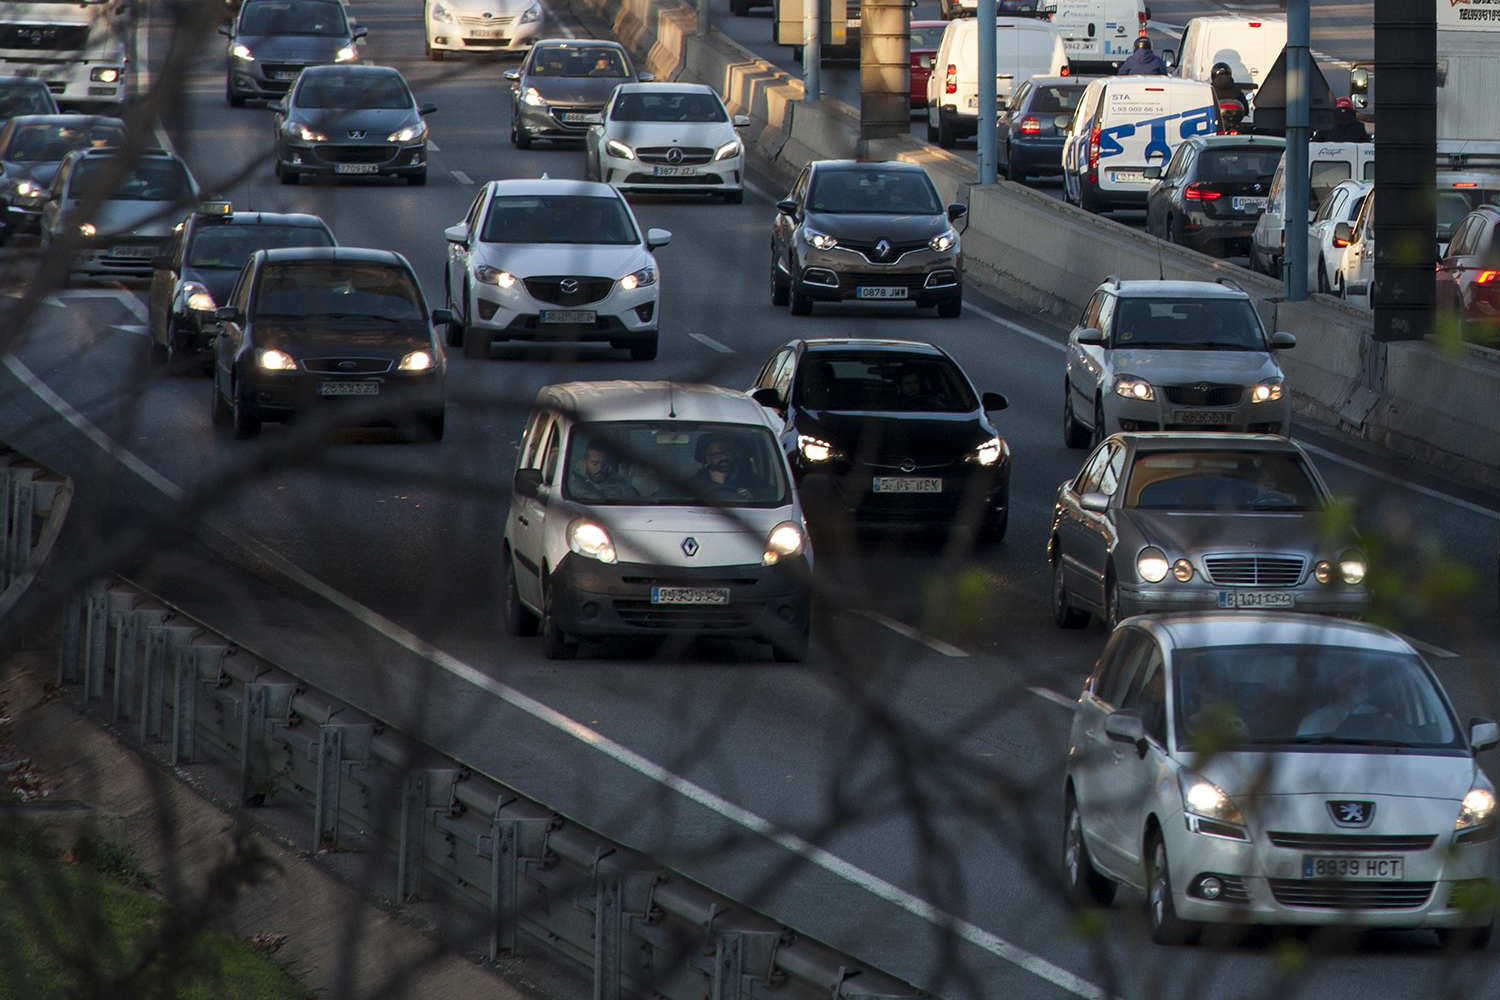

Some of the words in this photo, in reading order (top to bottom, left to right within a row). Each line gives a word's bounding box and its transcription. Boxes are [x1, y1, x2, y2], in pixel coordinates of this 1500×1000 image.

[863, 288, 886, 297] 0878
[1316, 860, 1360, 876] 8939
[1366, 860, 1399, 876] HCT
